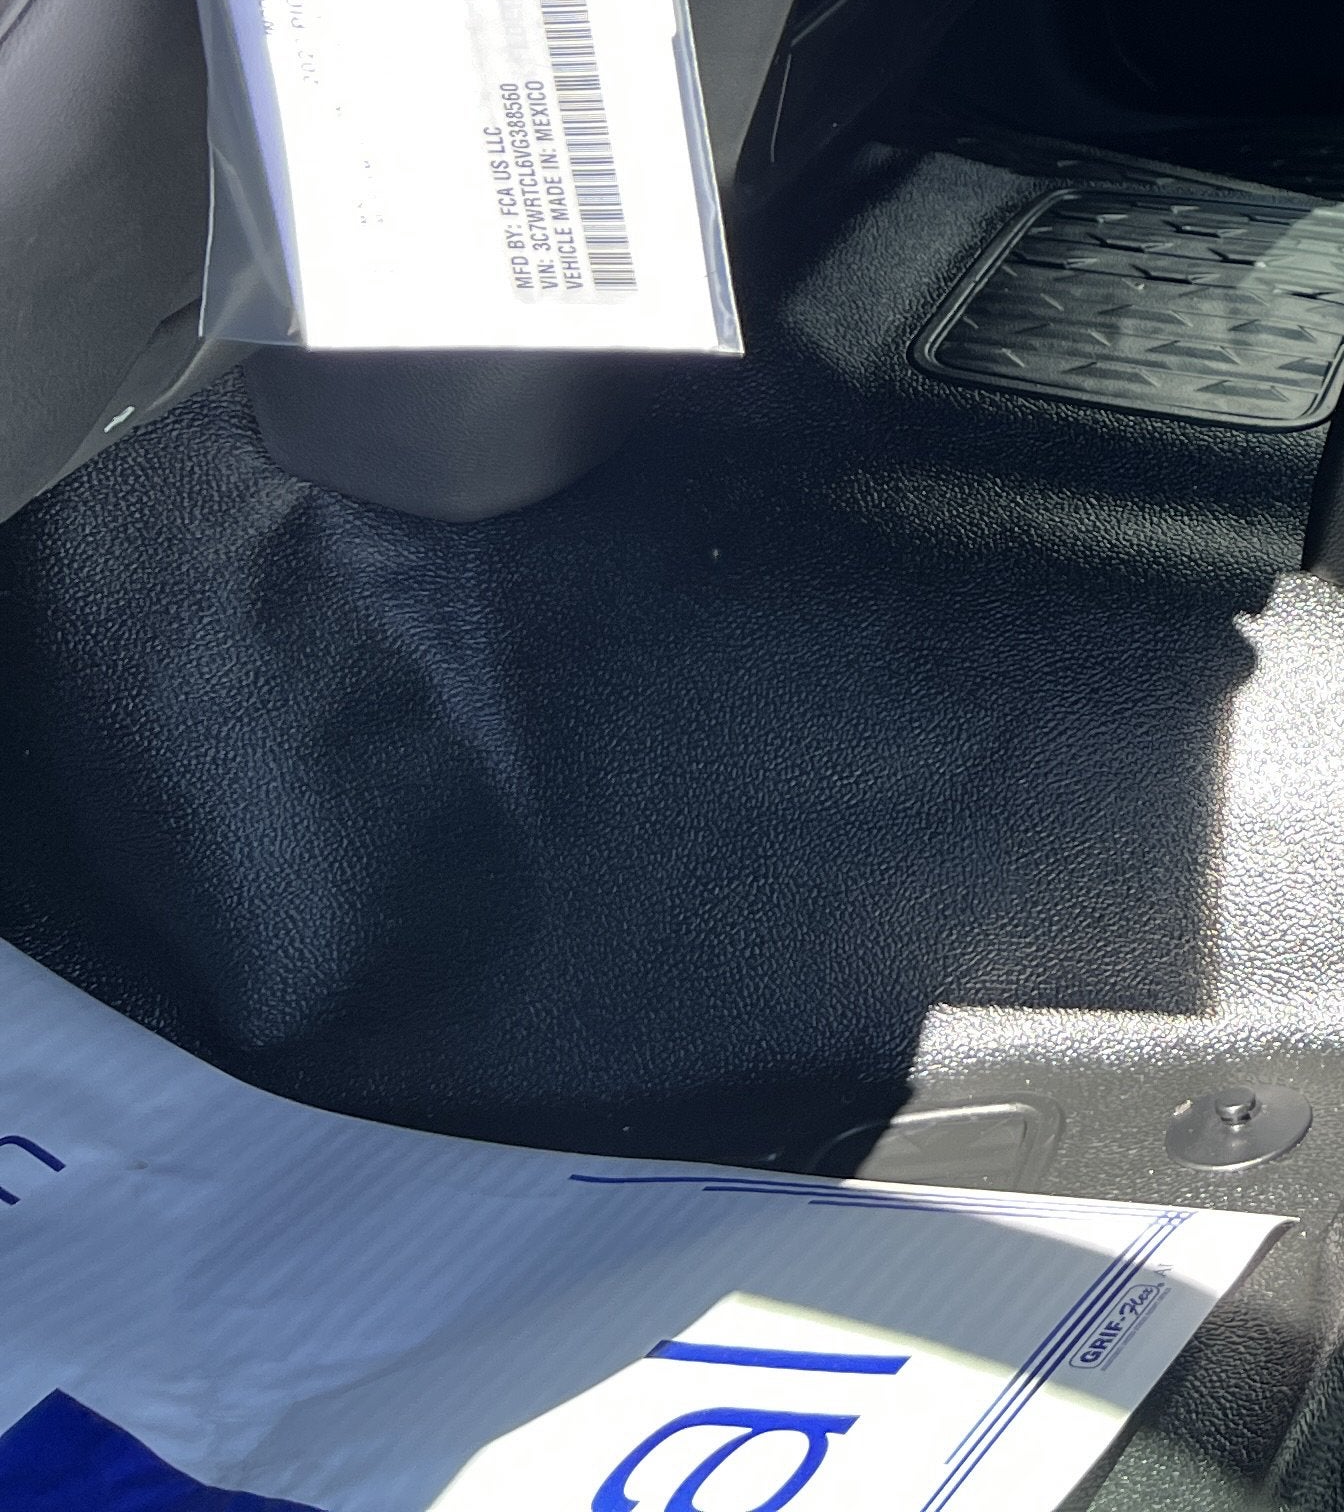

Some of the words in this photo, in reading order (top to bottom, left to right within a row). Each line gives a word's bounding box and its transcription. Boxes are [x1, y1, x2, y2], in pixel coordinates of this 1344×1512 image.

[524, 79, 554, 141] MEXICO
[482, 125, 505, 153] LLC
[489, 158, 511, 180] US
[538, 147, 559, 169] IN:
[496, 186, 519, 215] FCA
[543, 175, 569, 220] MADE
[510, 254, 534, 288] MFD
[536, 258, 558, 289] VIN:
[553, 226, 583, 290] VEHICLE
